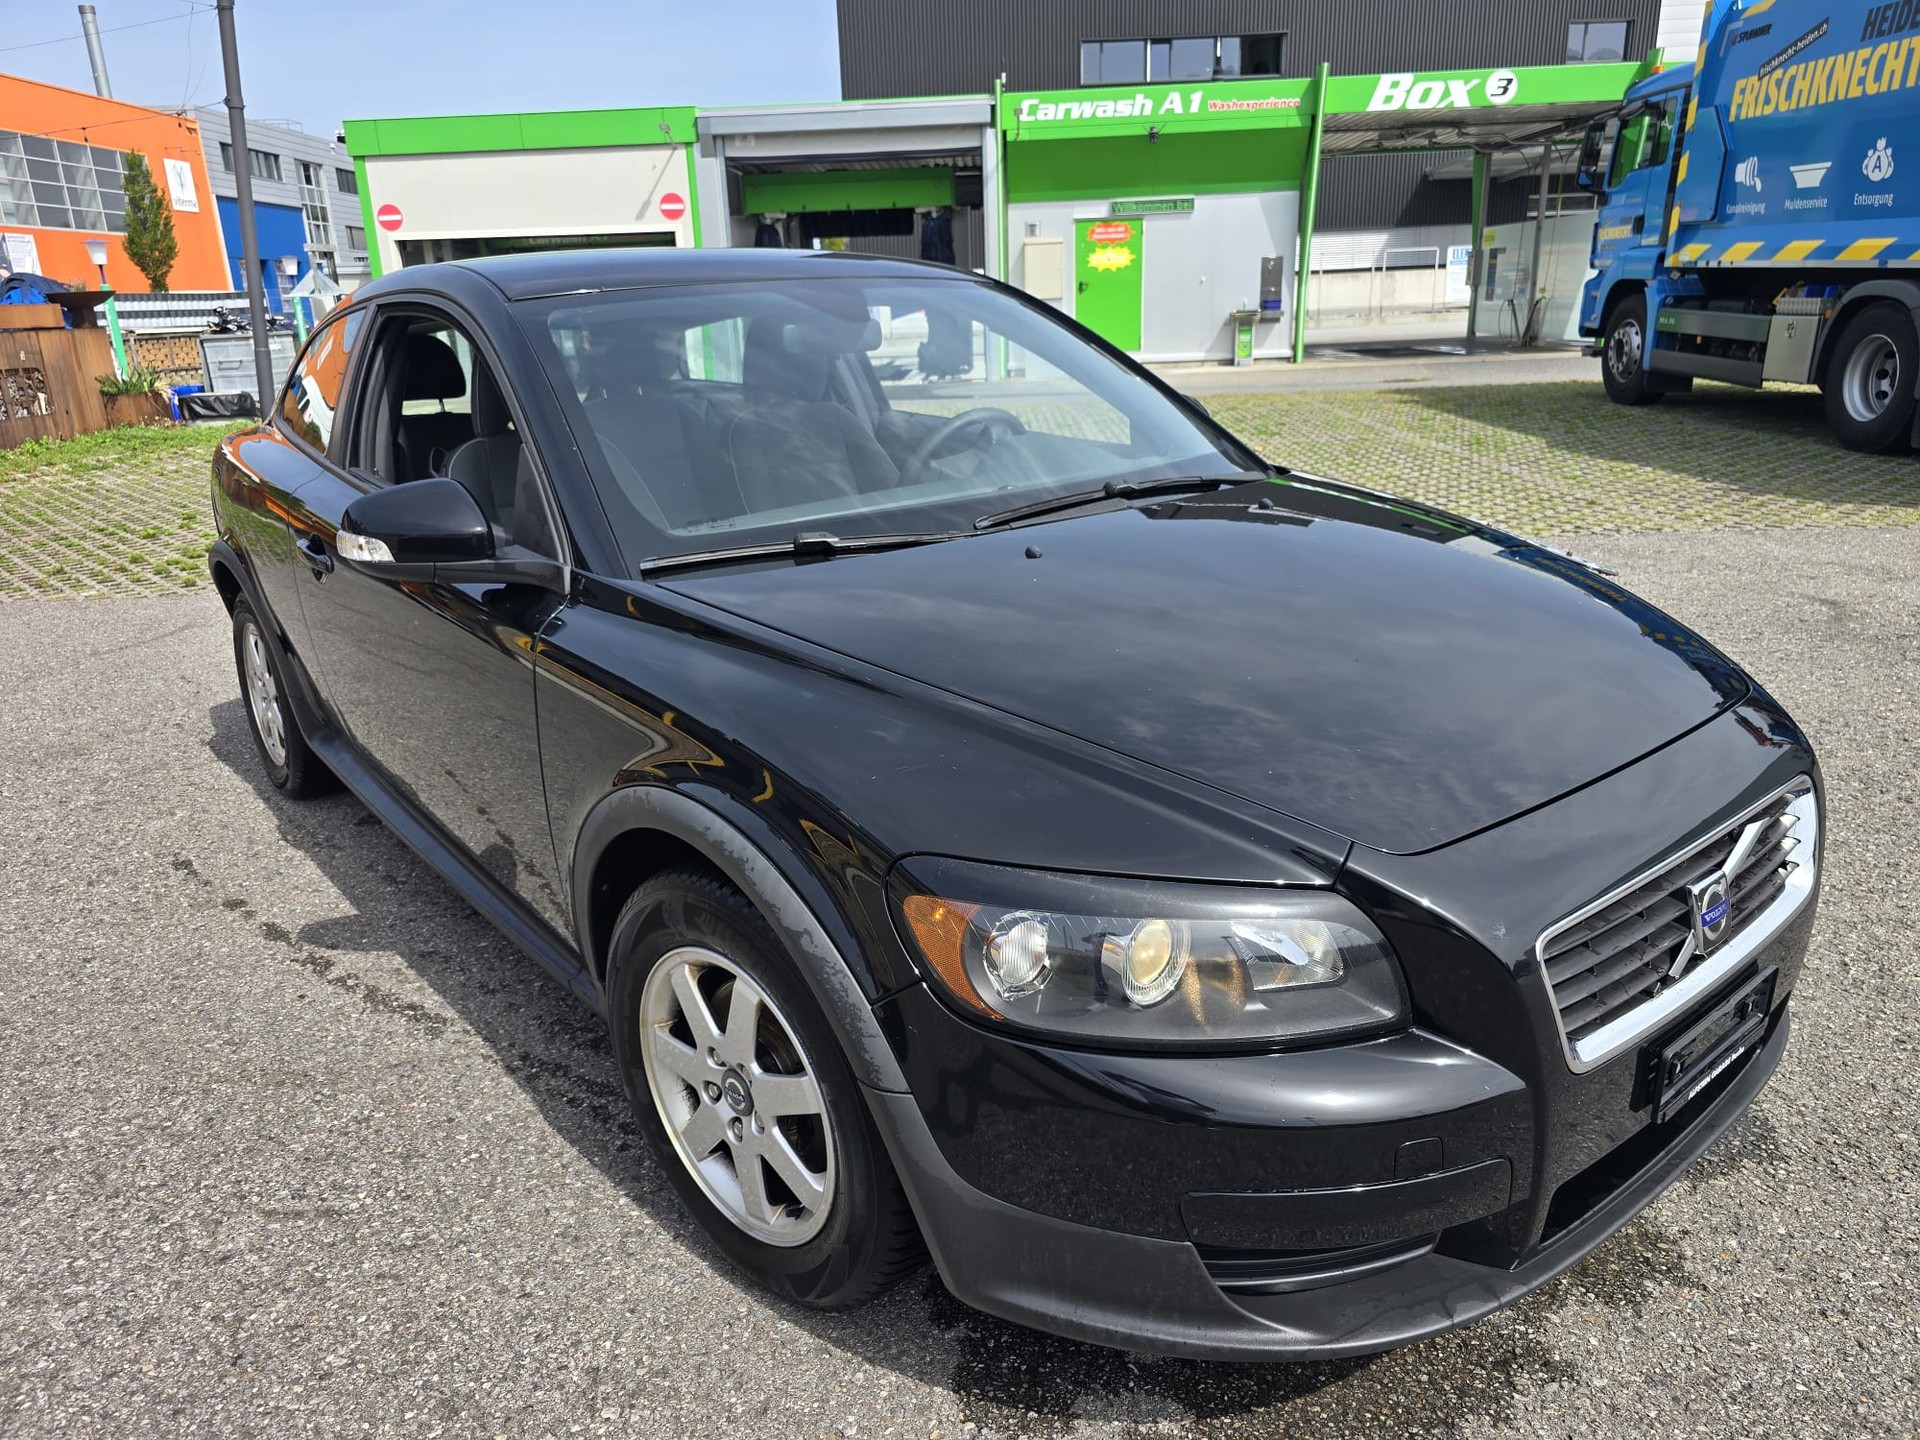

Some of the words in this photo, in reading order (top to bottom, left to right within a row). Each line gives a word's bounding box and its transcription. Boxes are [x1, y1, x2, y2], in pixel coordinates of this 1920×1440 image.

[1729, 35, 1920, 122] FRISCHKNECHT
[1366, 72, 1482, 111] Box
[1490, 77, 1514, 97] 3
[1019, 94, 1153, 121] Carwash
[1208, 97, 1301, 112] Washexperience
[1784, 197, 1828, 211] Muldenservice
[1853, 193, 1894, 207] Entsorgung
[1112, 201, 1175, 214] Willkommen
[1726, 202, 1766, 215] Kanalreinigung
